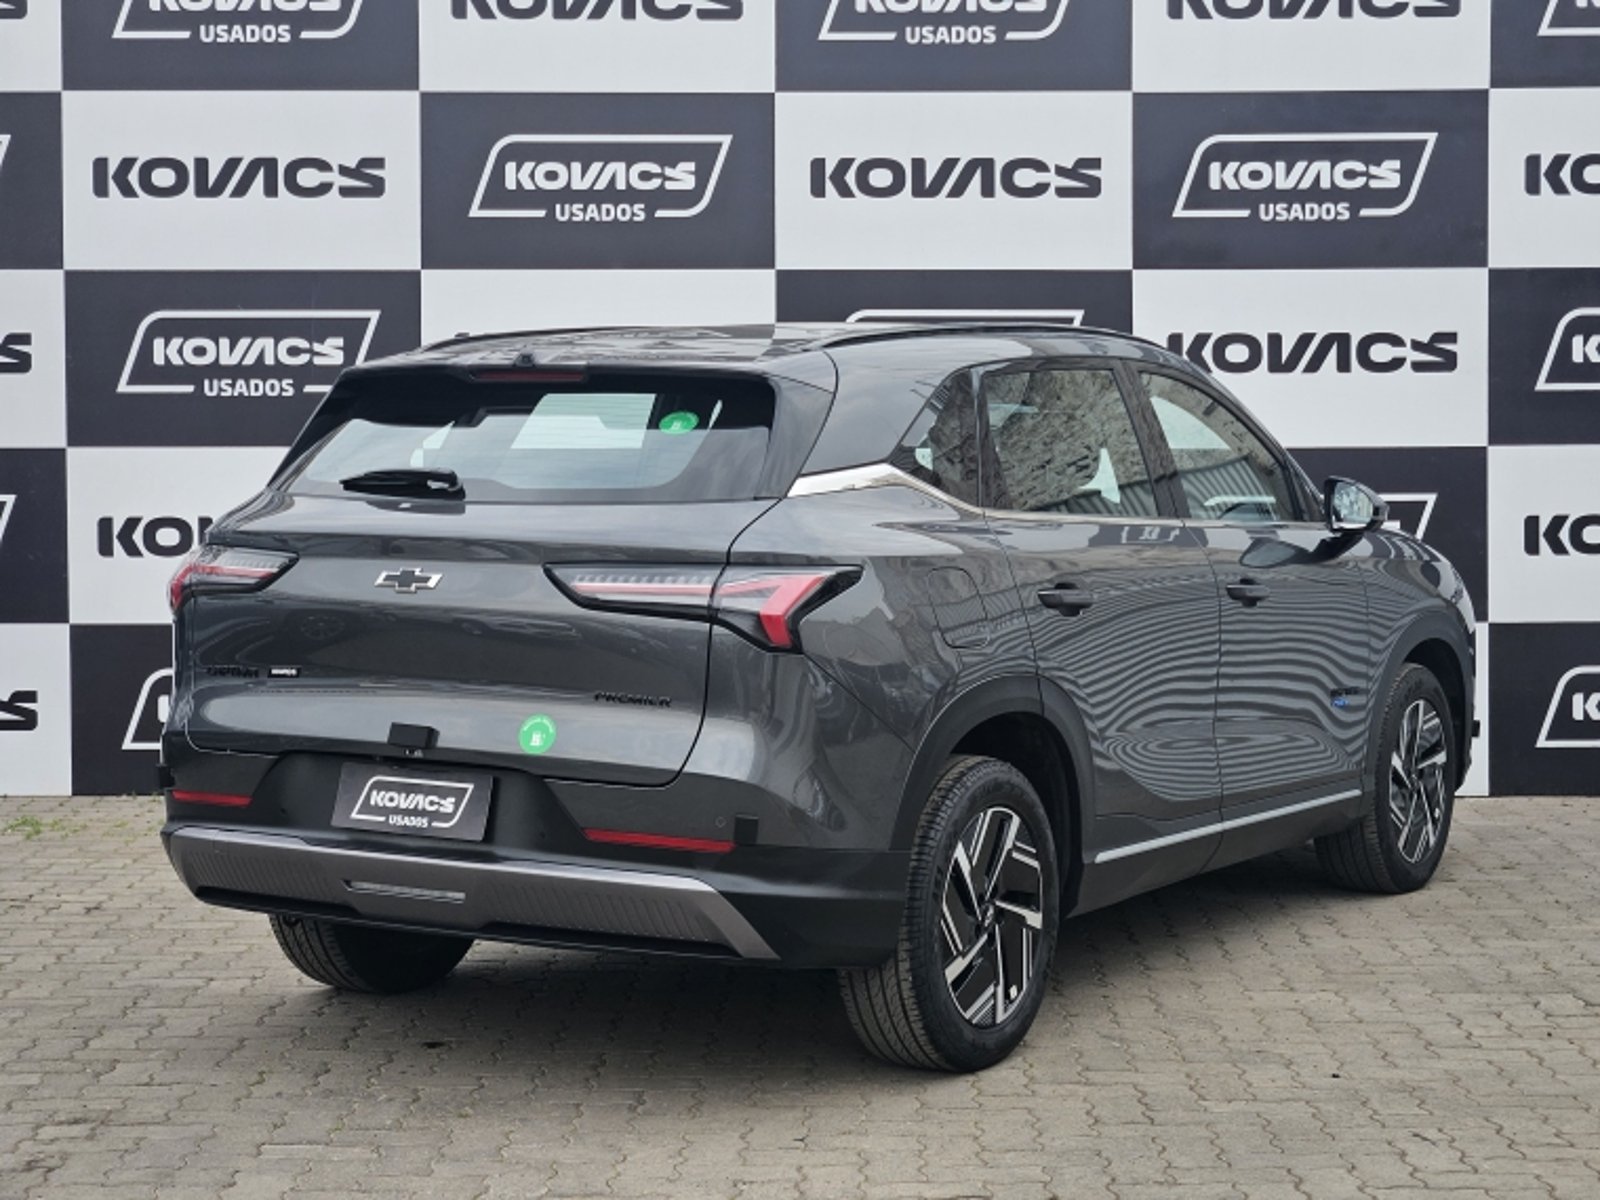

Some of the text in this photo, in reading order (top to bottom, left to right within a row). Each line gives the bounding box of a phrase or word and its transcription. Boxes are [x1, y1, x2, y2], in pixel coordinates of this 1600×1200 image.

[199, 25, 292, 43] USADOS
[905, 26, 997, 44] USADOS
[93, 157, 386, 198] KOVACS
[505, 162, 696, 190] KOVACS
[810, 157, 1102, 198] KOVACS
[1208, 160, 1401, 190] KOVACS
[555, 203, 646, 222] USADOS
[1259, 202, 1351, 221] USADOS
[153, 337, 344, 366] KOVACS
[1167, 332, 1458, 373] KOVACS
[203, 379, 295, 397] USADOS
[370, 789, 456, 813] KOVACS
